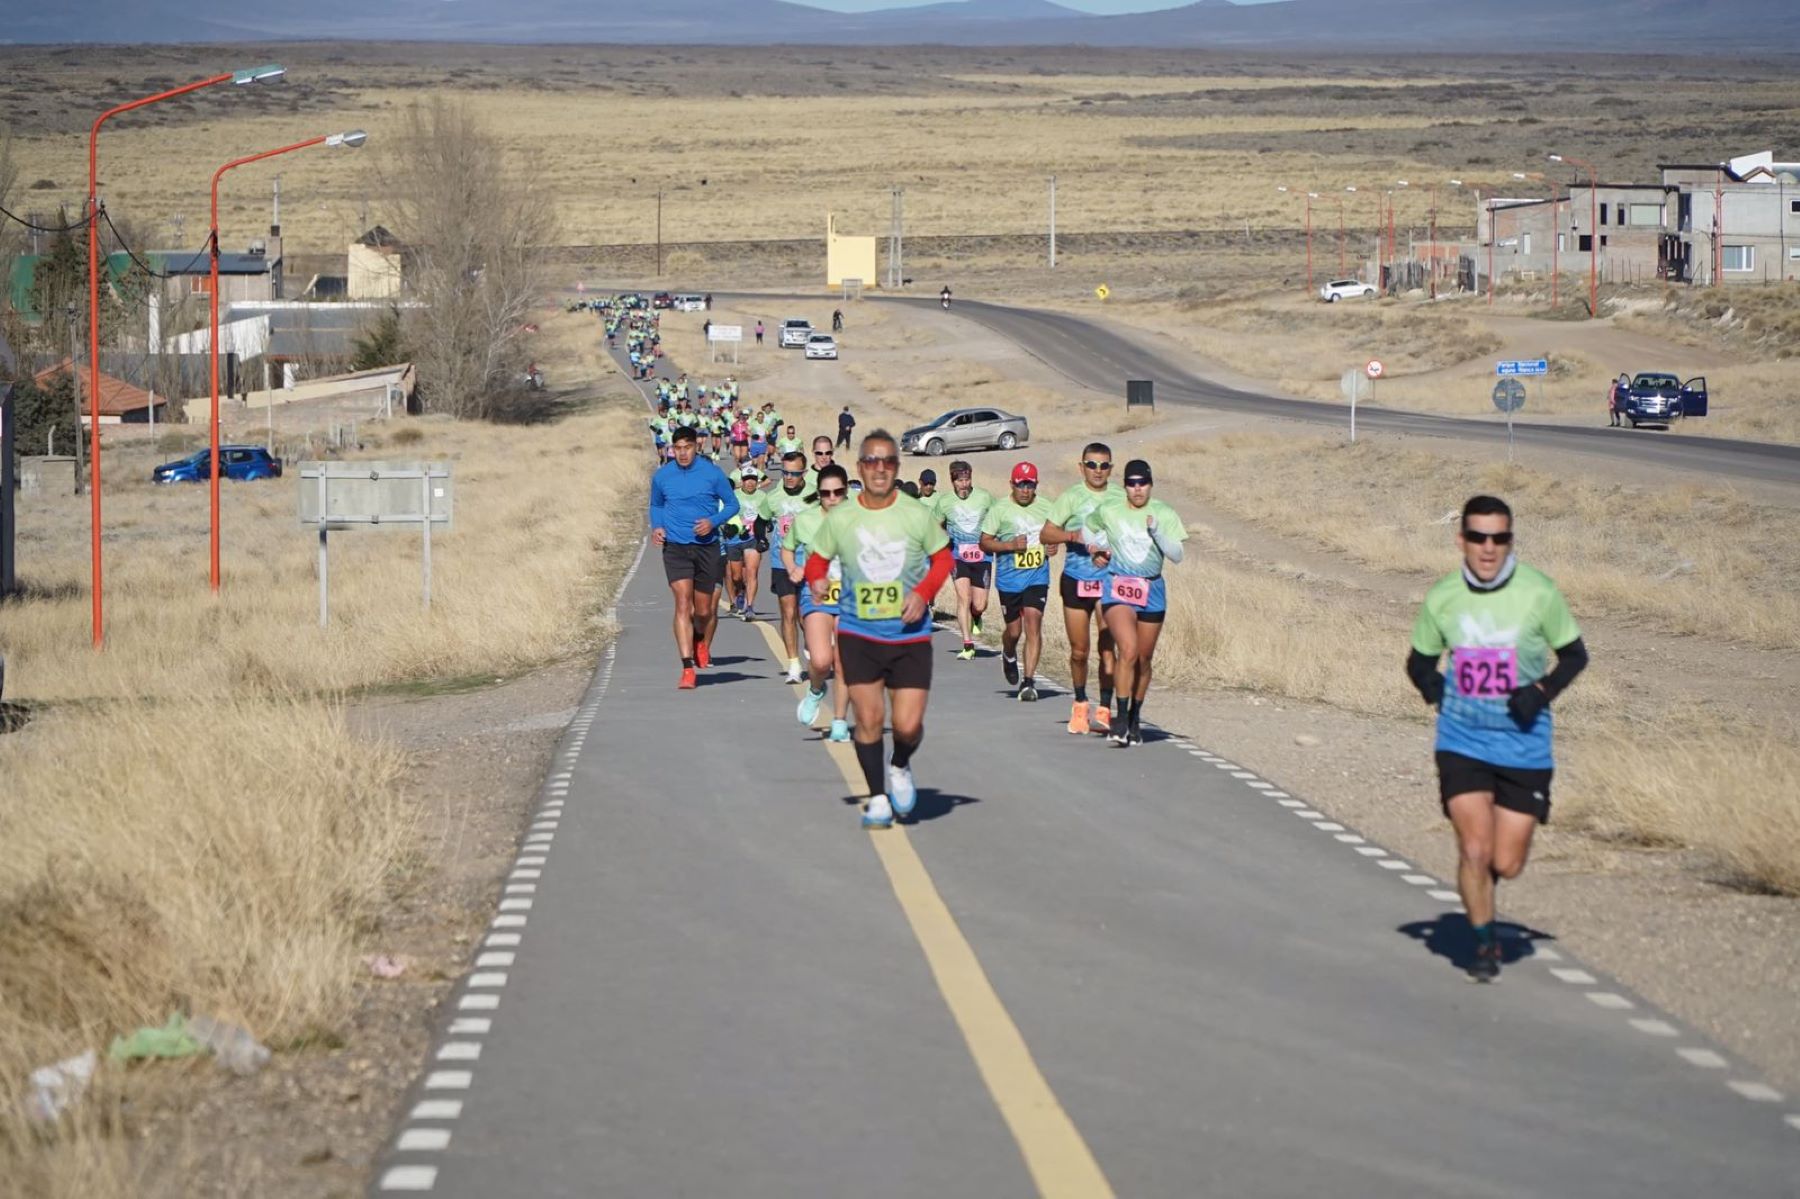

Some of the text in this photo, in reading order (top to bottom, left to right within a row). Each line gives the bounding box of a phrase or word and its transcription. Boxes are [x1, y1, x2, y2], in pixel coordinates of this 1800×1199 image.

[963, 550, 980, 559] 616
[1018, 550, 1042, 567] 203
[861, 586, 898, 605] 279
[1117, 585, 1143, 600] 630
[1460, 661, 1512, 696] 625
